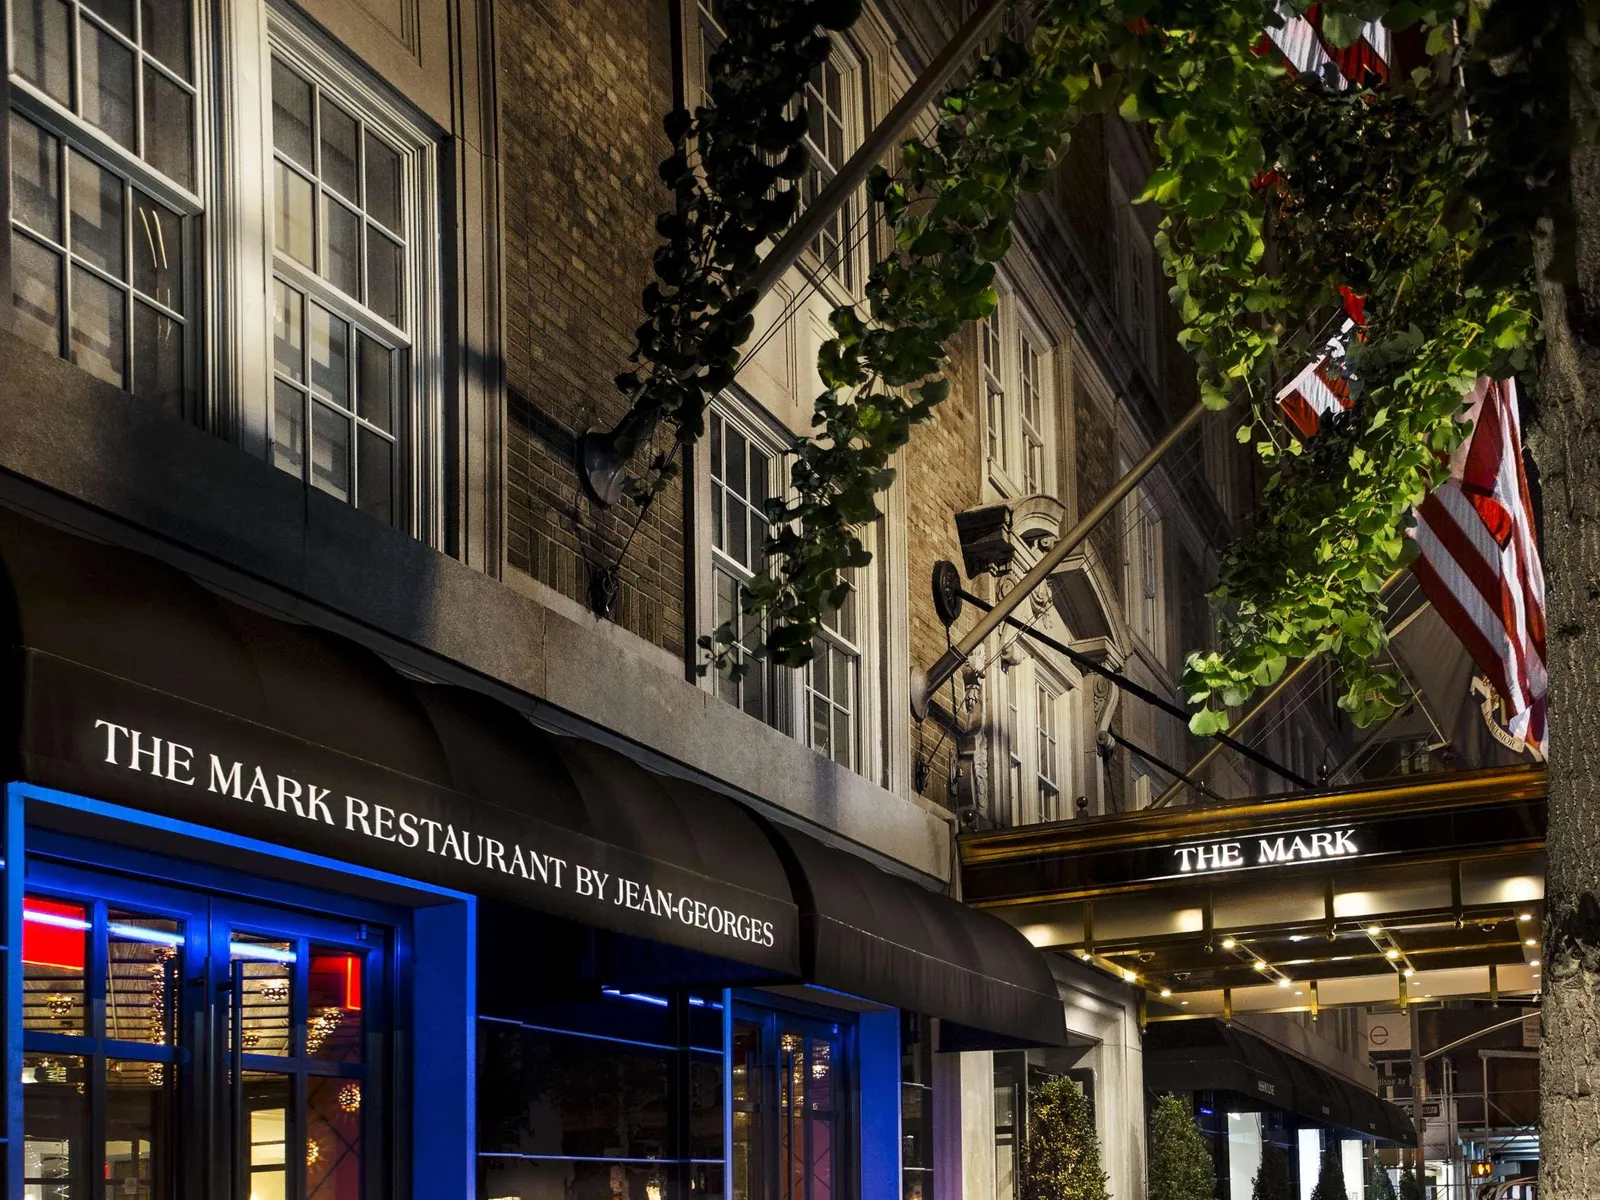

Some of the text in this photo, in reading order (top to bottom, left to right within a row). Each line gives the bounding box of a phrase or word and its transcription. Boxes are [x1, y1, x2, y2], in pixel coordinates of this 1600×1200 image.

[95, 719, 775, 948] THE MARK RESTAURANT BY JEAN-GEORGES
[1174, 829, 1359, 872] THE MARK
